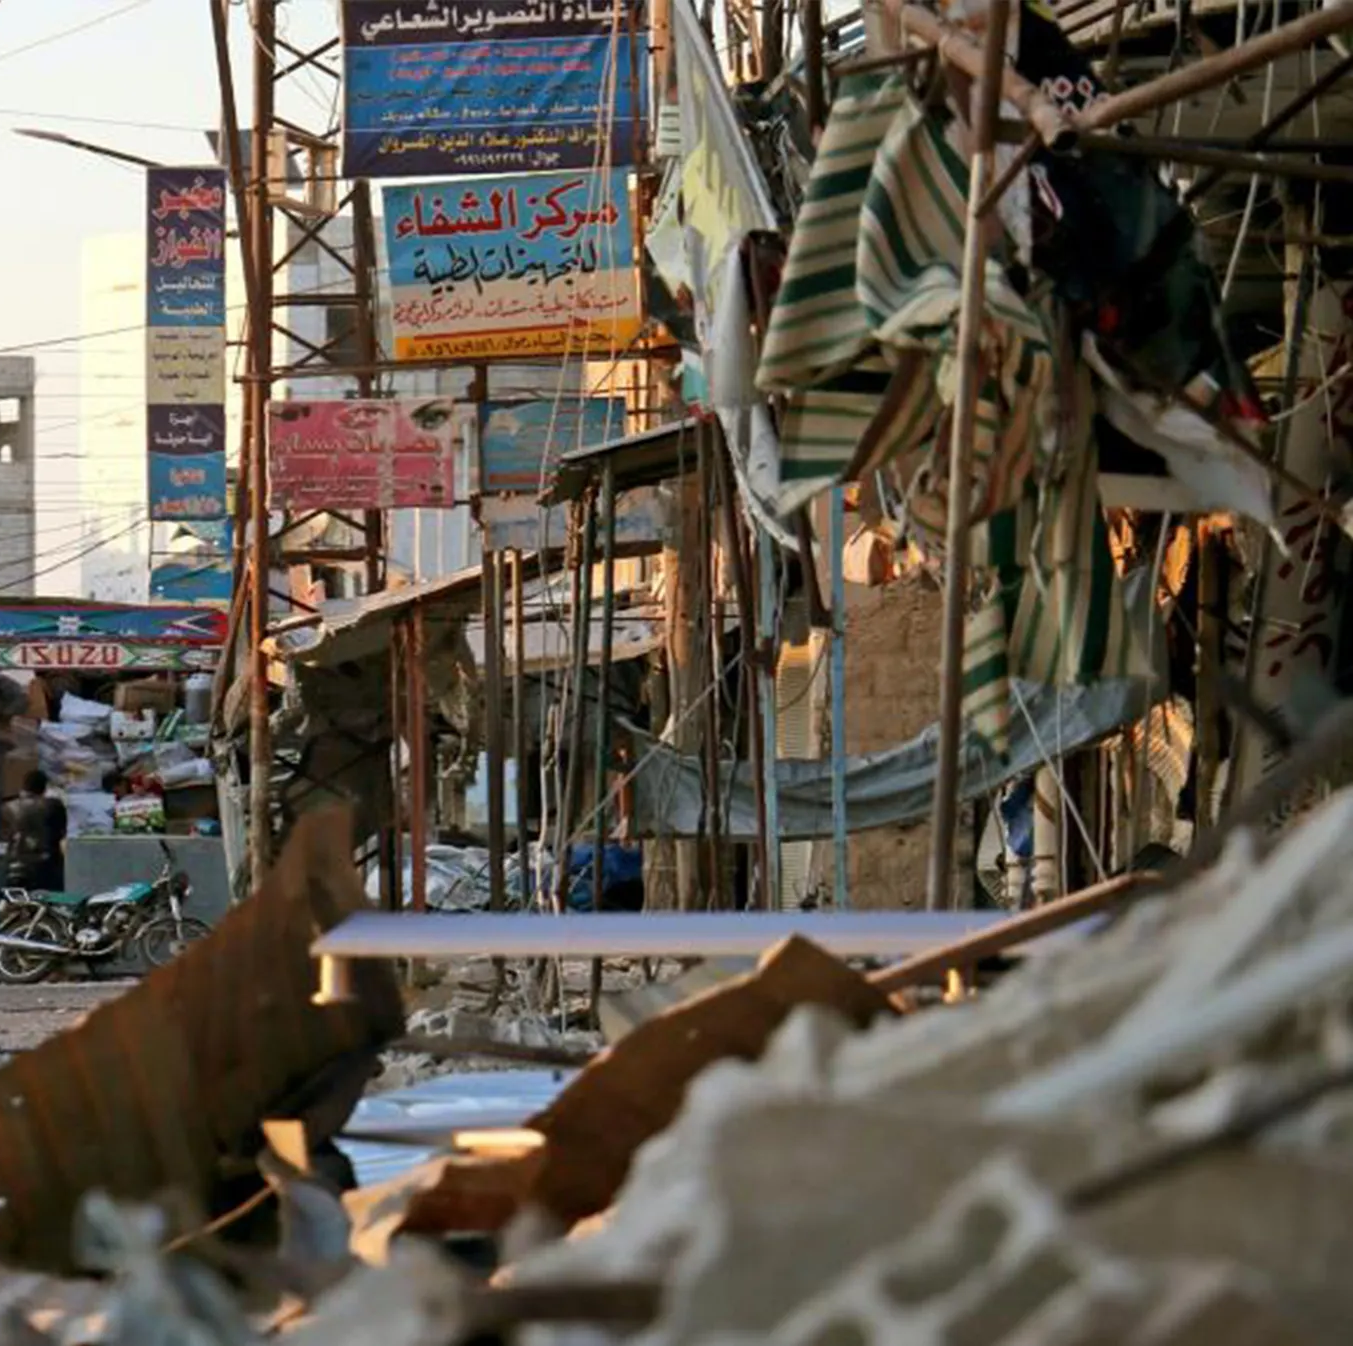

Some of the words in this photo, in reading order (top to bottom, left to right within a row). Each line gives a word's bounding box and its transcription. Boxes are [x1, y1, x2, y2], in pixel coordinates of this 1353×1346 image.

[360, 0, 458, 41] الشعاعي
[456, 0, 556, 34] التصوير
[152, 175, 223, 220] مخبر
[395, 187, 518, 240] الشفاء
[521, 180, 619, 240] مركز
[151, 226, 222, 268] الفواز
[478, 239, 597, 286] للتجهيزات
[19, 644, 120, 666] ISUZU
